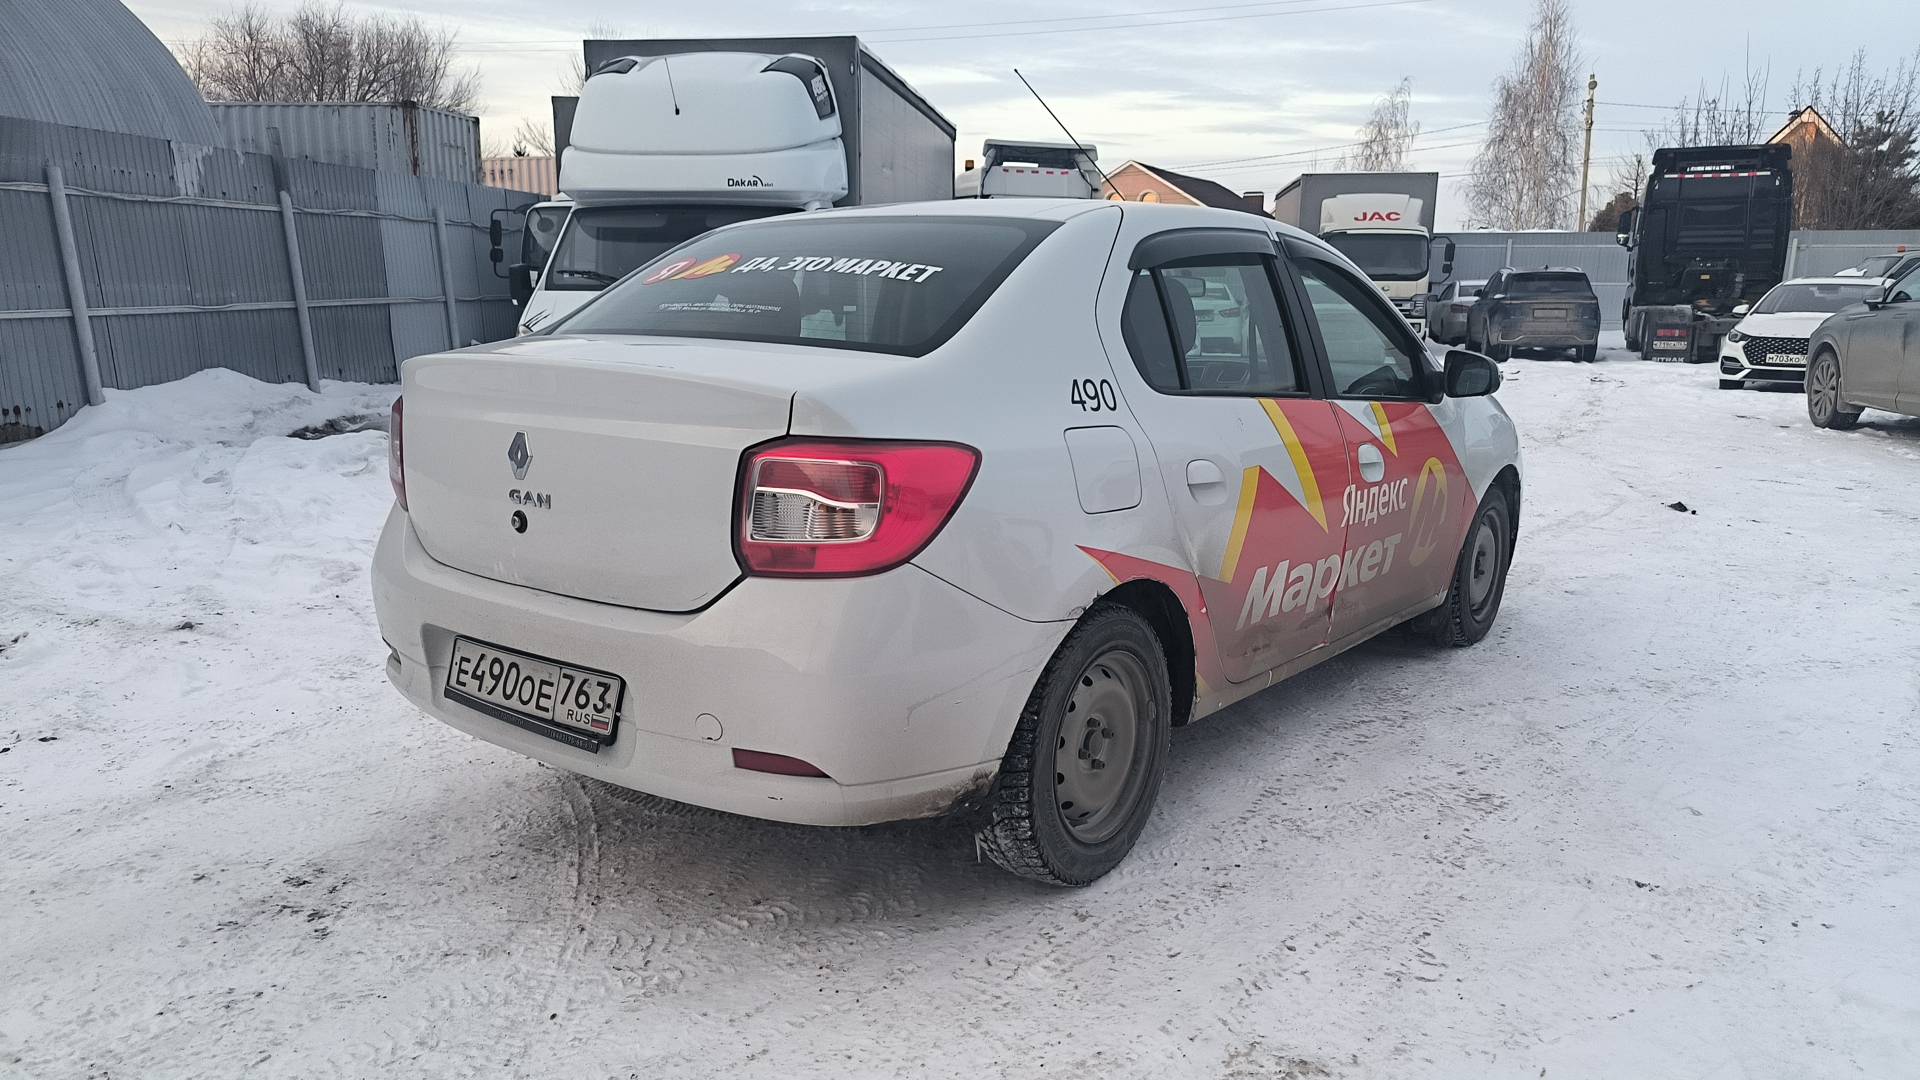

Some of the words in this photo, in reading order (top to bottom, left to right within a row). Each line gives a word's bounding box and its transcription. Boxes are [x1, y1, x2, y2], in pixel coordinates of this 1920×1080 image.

[1353, 211, 1401, 221] JAC
[730, 256, 779, 274] ДА,
[777, 256, 834, 272] ЭТО
[824, 258, 943, 284] МАРКЕТ
[1070, 378, 1117, 412] 490
[508, 488, 552, 510] GAN
[1341, 477, 1408, 528] Яндекс
[1235, 532, 1402, 632] Маркет
[560, 672, 611, 714] 763
[566, 708, 591, 725] RUS
